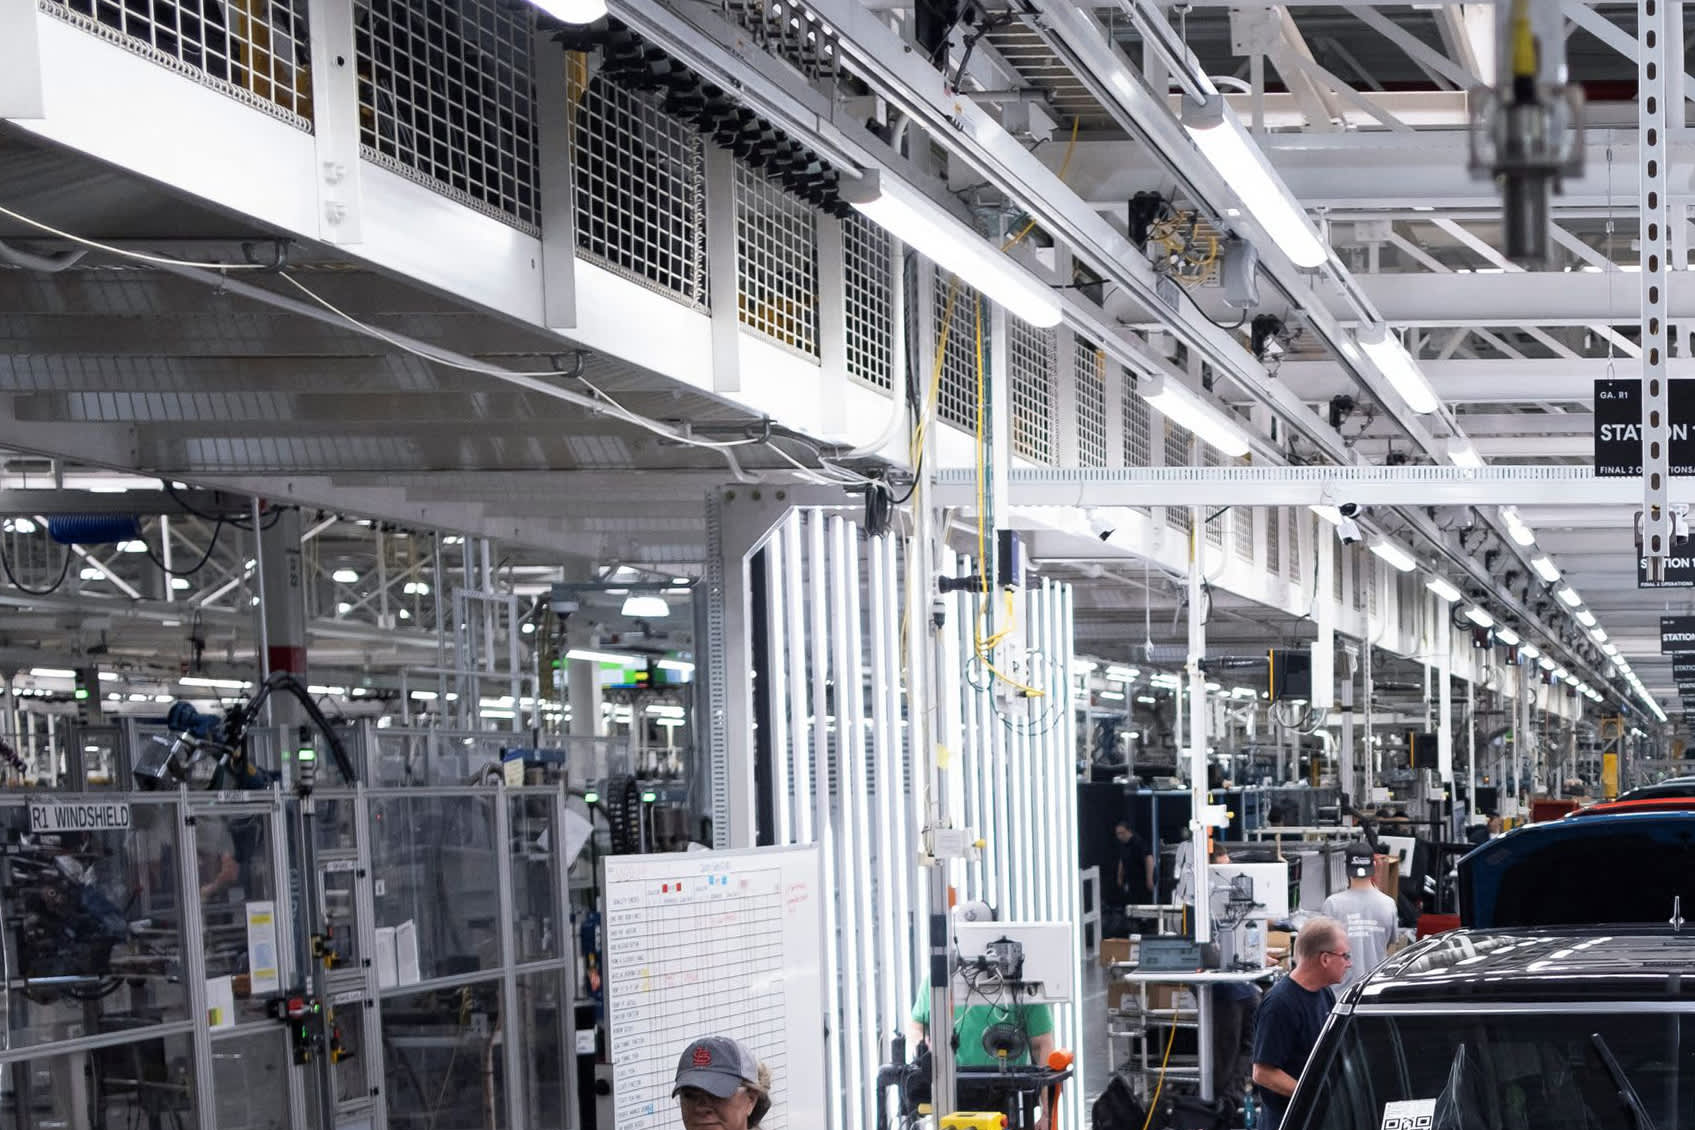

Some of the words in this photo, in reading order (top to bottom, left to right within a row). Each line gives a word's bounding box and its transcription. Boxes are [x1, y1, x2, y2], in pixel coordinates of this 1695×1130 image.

[1600, 466, 1626, 474] FINAL
[1628, 466, 1634, 474] 2
[1640, 557, 1690, 569] STION
[32, 807, 48, 828] R1
[55, 805, 129, 828] WINDSHIELD
